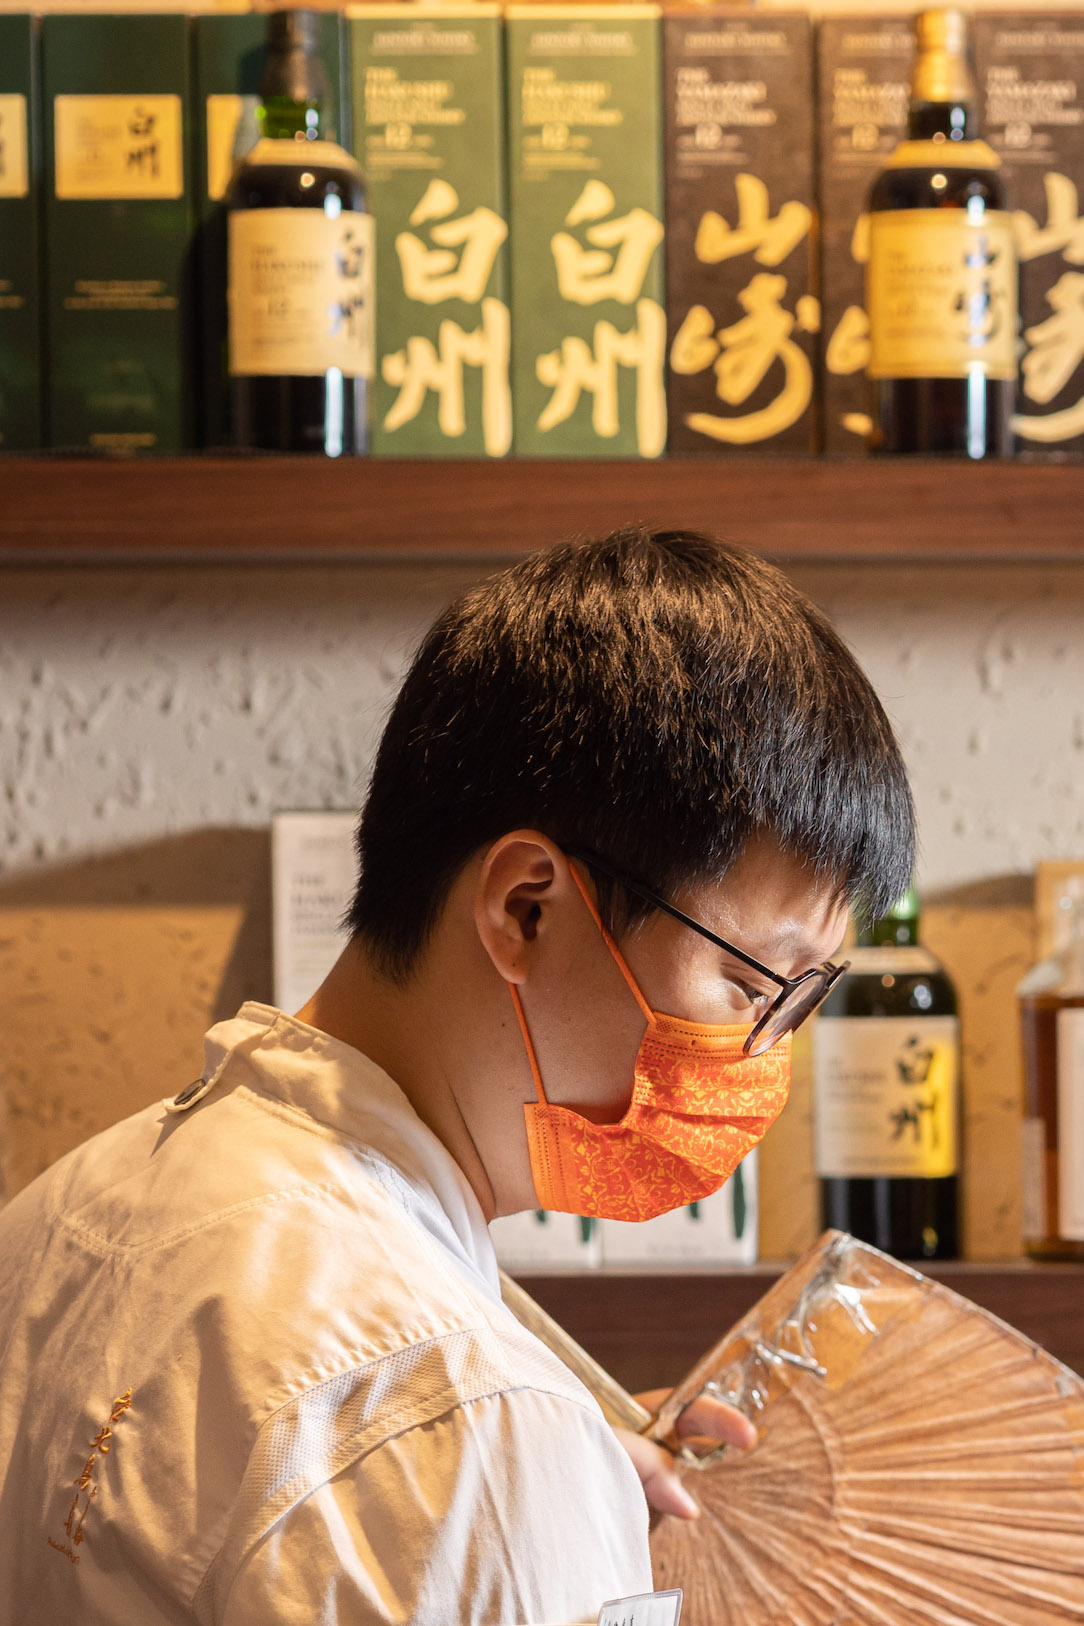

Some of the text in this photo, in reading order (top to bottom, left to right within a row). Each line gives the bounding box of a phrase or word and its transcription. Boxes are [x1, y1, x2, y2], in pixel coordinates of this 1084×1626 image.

[382, 178, 512, 457] 白州
[536, 179, 667, 457] 白州
[889, 1034, 941, 1151] 白州
